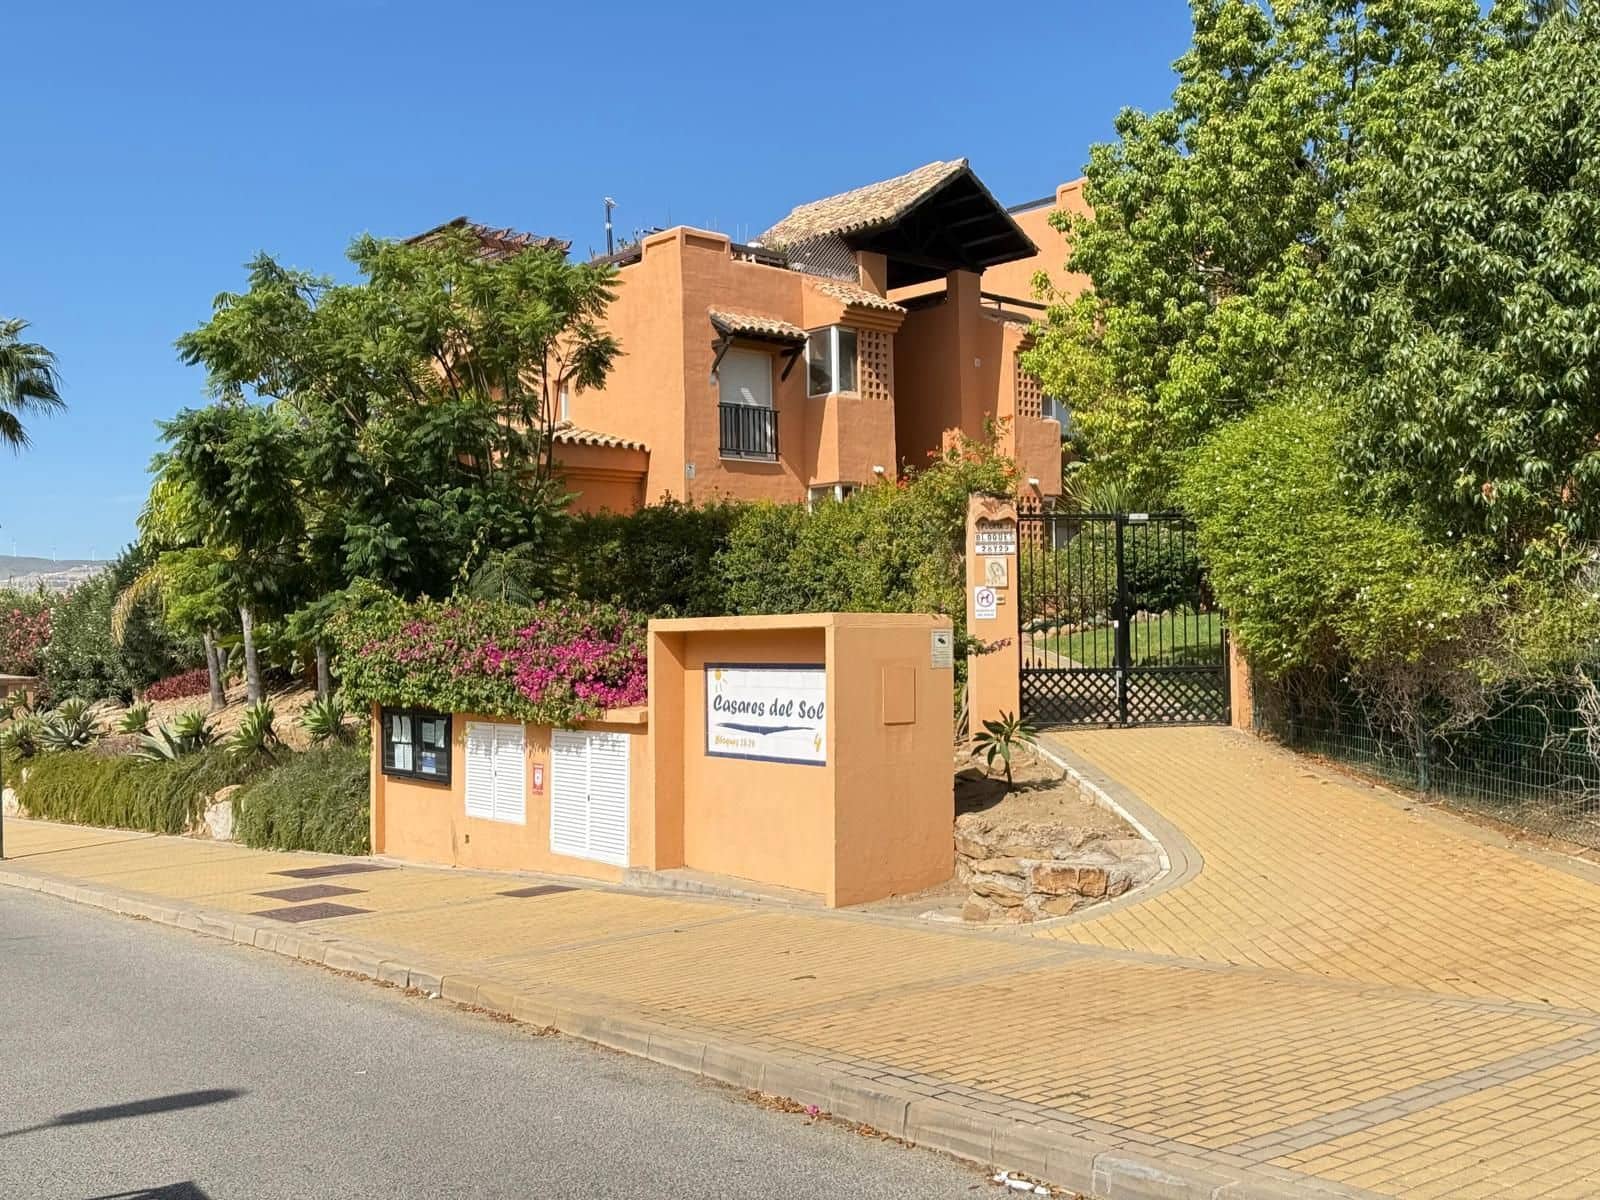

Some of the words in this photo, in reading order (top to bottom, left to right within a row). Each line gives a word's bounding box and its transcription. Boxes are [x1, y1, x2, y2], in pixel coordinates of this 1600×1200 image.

[713, 694, 765, 717] Casares
[769, 697, 793, 717] del
[798, 700, 825, 720] Sol
